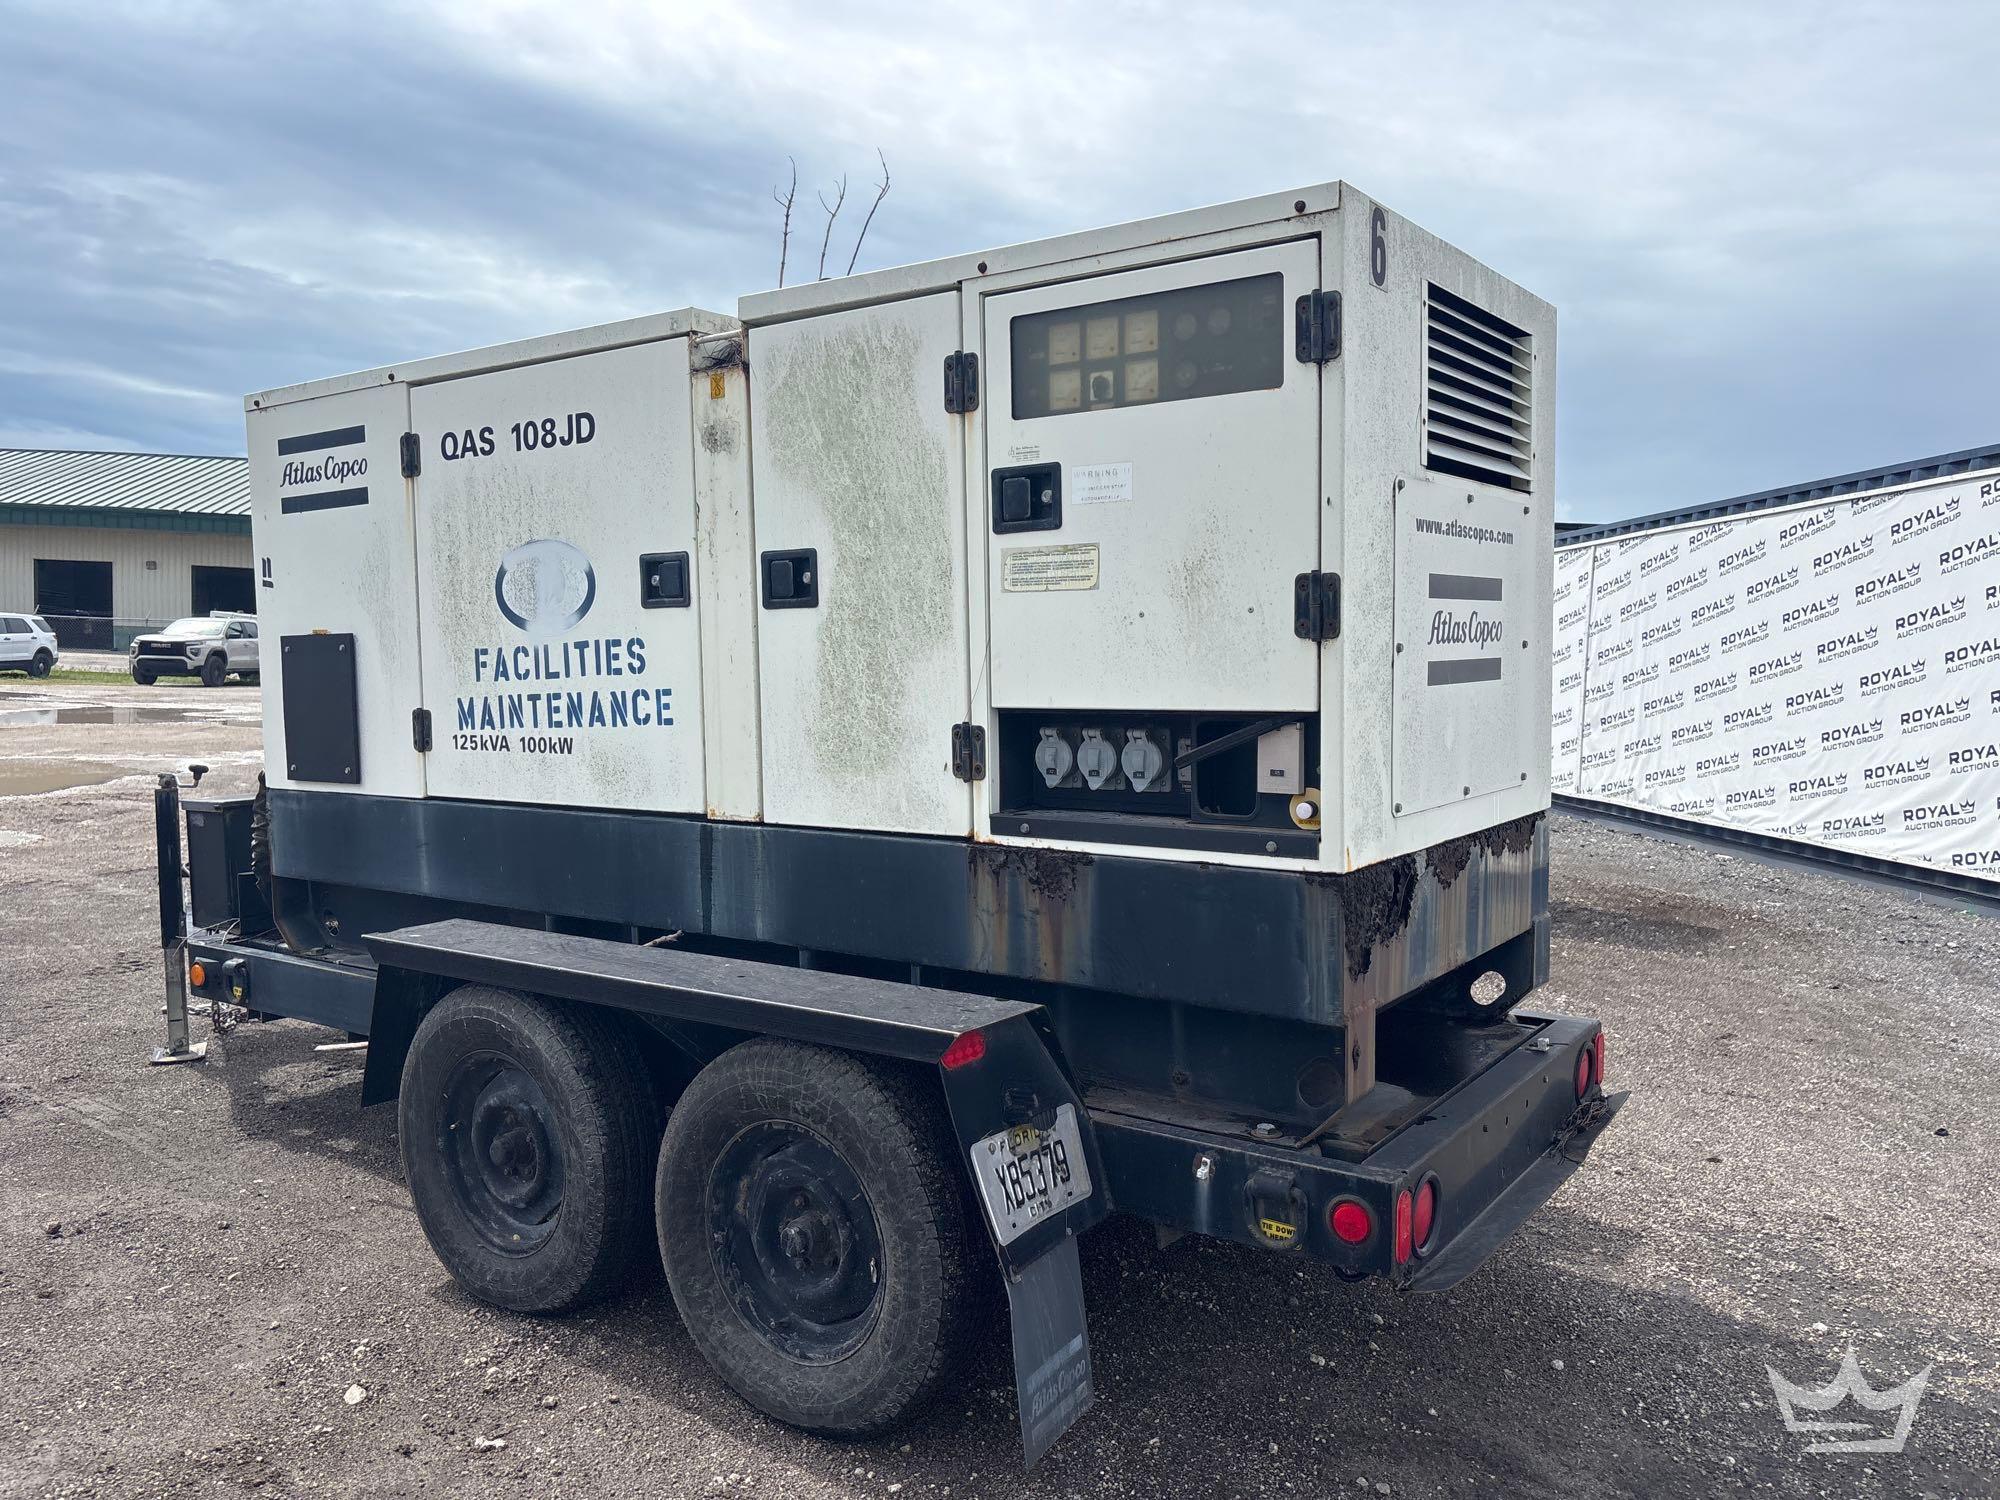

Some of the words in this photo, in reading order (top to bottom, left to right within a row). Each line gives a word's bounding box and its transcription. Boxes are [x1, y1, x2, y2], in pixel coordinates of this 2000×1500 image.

[1370, 206, 1387, 286] 6
[440, 430, 495, 461] QAS
[510, 412, 596, 452] 108JD
[280, 458, 322, 487] Atlas
[324, 456, 368, 484] Copco
[1780, 514, 1823, 541] ROYAL
[1890, 506, 1945, 536] ROYAL
[1892, 526, 1928, 546] AUCTION
[1931, 512, 1961, 529] GROUP
[1416, 517, 1514, 546] www.atlascopco.com
[1689, 523, 1723, 546] ROYAL
[1781, 532, 1810, 549] AUCTION
[1811, 520, 1836, 535] GROUP
[1718, 546, 1755, 569] ROYAL
[1814, 542, 1860, 569] ROYAL
[1940, 535, 1998, 566] ROYAL
[1641, 550, 1670, 572] ROYAL
[1815, 561, 1846, 578] AUCTION
[1848, 548, 1874, 564] GROUP
[1941, 555, 1980, 576] AUCTION
[1597, 576, 1624, 594] ROYAL
[1666, 573, 1698, 594] ROYAL
[1747, 573, 1787, 597] ROYAL
[1748, 590, 1774, 604] AUCTION
[1776, 580, 1799, 592] GROUP
[1855, 570, 1906, 597] ROYAL
[1856, 589, 1890, 606] AUCTION
[1892, 578, 1921, 593] GROUP
[1559, 608, 1581, 625] ROYAL
[1620, 597, 1648, 616] ROYAL
[1691, 599, 1725, 620] ROYAL
[1783, 600, 1826, 624] ROYAL
[1896, 603, 1950, 630] ROYAL
[1428, 610, 1468, 645] Atlas
[1468, 610, 1503, 650] Copco
[1783, 616, 1813, 632] AUCTION
[1814, 608, 1839, 620] GROUP
[1897, 622, 1934, 640] AUCTION
[1936, 612, 1966, 627] GROUP
[1642, 622, 1672, 641] ROYAL
[1721, 626, 1757, 647] ROYAL
[1598, 643, 1626, 660] ROYAL
[1817, 632, 1864, 655] ROYAL
[1818, 650, 1850, 664] AUCTION
[1852, 640, 1878, 653] GROUP
[475, 638, 646, 682] FACILITIES
[1669, 648, 1700, 666] ROYAL
[1750, 656, 1790, 677] ROYAL
[1946, 658, 1985, 674] AUCTION
[1622, 667, 1651, 684] ROYAL
[1750, 672, 1778, 685] AUCTION
[1779, 664, 1802, 676] GROUP
[1860, 665, 1911, 688] ROYAL
[1694, 677, 1727, 695] ROYAL
[1861, 683, 1895, 697] AUCTION
[1897, 674, 1926, 687] GROUP
[1644, 695, 1675, 711] ROYAL
[1786, 688, 1830, 708] ROYAL
[1787, 704, 1817, 716] AUCTION
[1818, 697, 1844, 708] GROUP
[457, 688, 674, 732] MAINTENANCE
[1600, 710, 1628, 726] ROYAL
[1724, 707, 1761, 725] ROYAL
[1901, 703, 1955, 725] ROYAL
[1672, 723, 1703, 740] ROYAL
[1822, 723, 1869, 743] ROYAL
[1902, 721, 1938, 735] AUCTION
[1940, 713, 1970, 726] GROUP
[452, 734, 510, 752] 125kVA
[520, 736, 574, 754] 100kW
[1624, 738, 1653, 753] ROYAL
[1753, 741, 1794, 758] ROYAL
[1822, 740, 1855, 752] AUCTION
[1856, 734, 1883, 744] GROUP
[1582, 751, 1608, 764] ROYAL
[1696, 755, 1730, 771] ROYAL
[1753, 755, 1781, 766] AUCTION
[1783, 751, 1806, 760] GROUP
[1949, 744, 2000, 764] ROYA
[1645, 768, 1676, 782] ROYAL
[1864, 761, 1915, 780] ROYAL
[1950, 762, 1990, 774] AUCTION
[1601, 781, 1627, 793] ROYAL
[1790, 776, 1834, 793] ROYAL
[1865, 778, 1899, 789] AUCTION
[1901, 773, 1931, 783] GROUP
[1726, 789, 1764, 804] ROYAL
[1790, 792, 1820, 801] AUCTION
[1822, 787, 1848, 796] GROUP
[1671, 800, 1704, 812] ROYAL
[1903, 803, 1959, 821] ROYAL
[1823, 816, 1871, 832] ROYAL
[1905, 821, 1943, 831] AUCTION
[1945, 816, 1976, 826] GROUP
[1823, 831, 1856, 840] AUCTION
[1858, 828, 1886, 836] GROUP
[1952, 850, 2000, 866] ROYA
[995, 1140, 1070, 1215] XB5379
[1262, 1222, 1273, 1230] TIE
